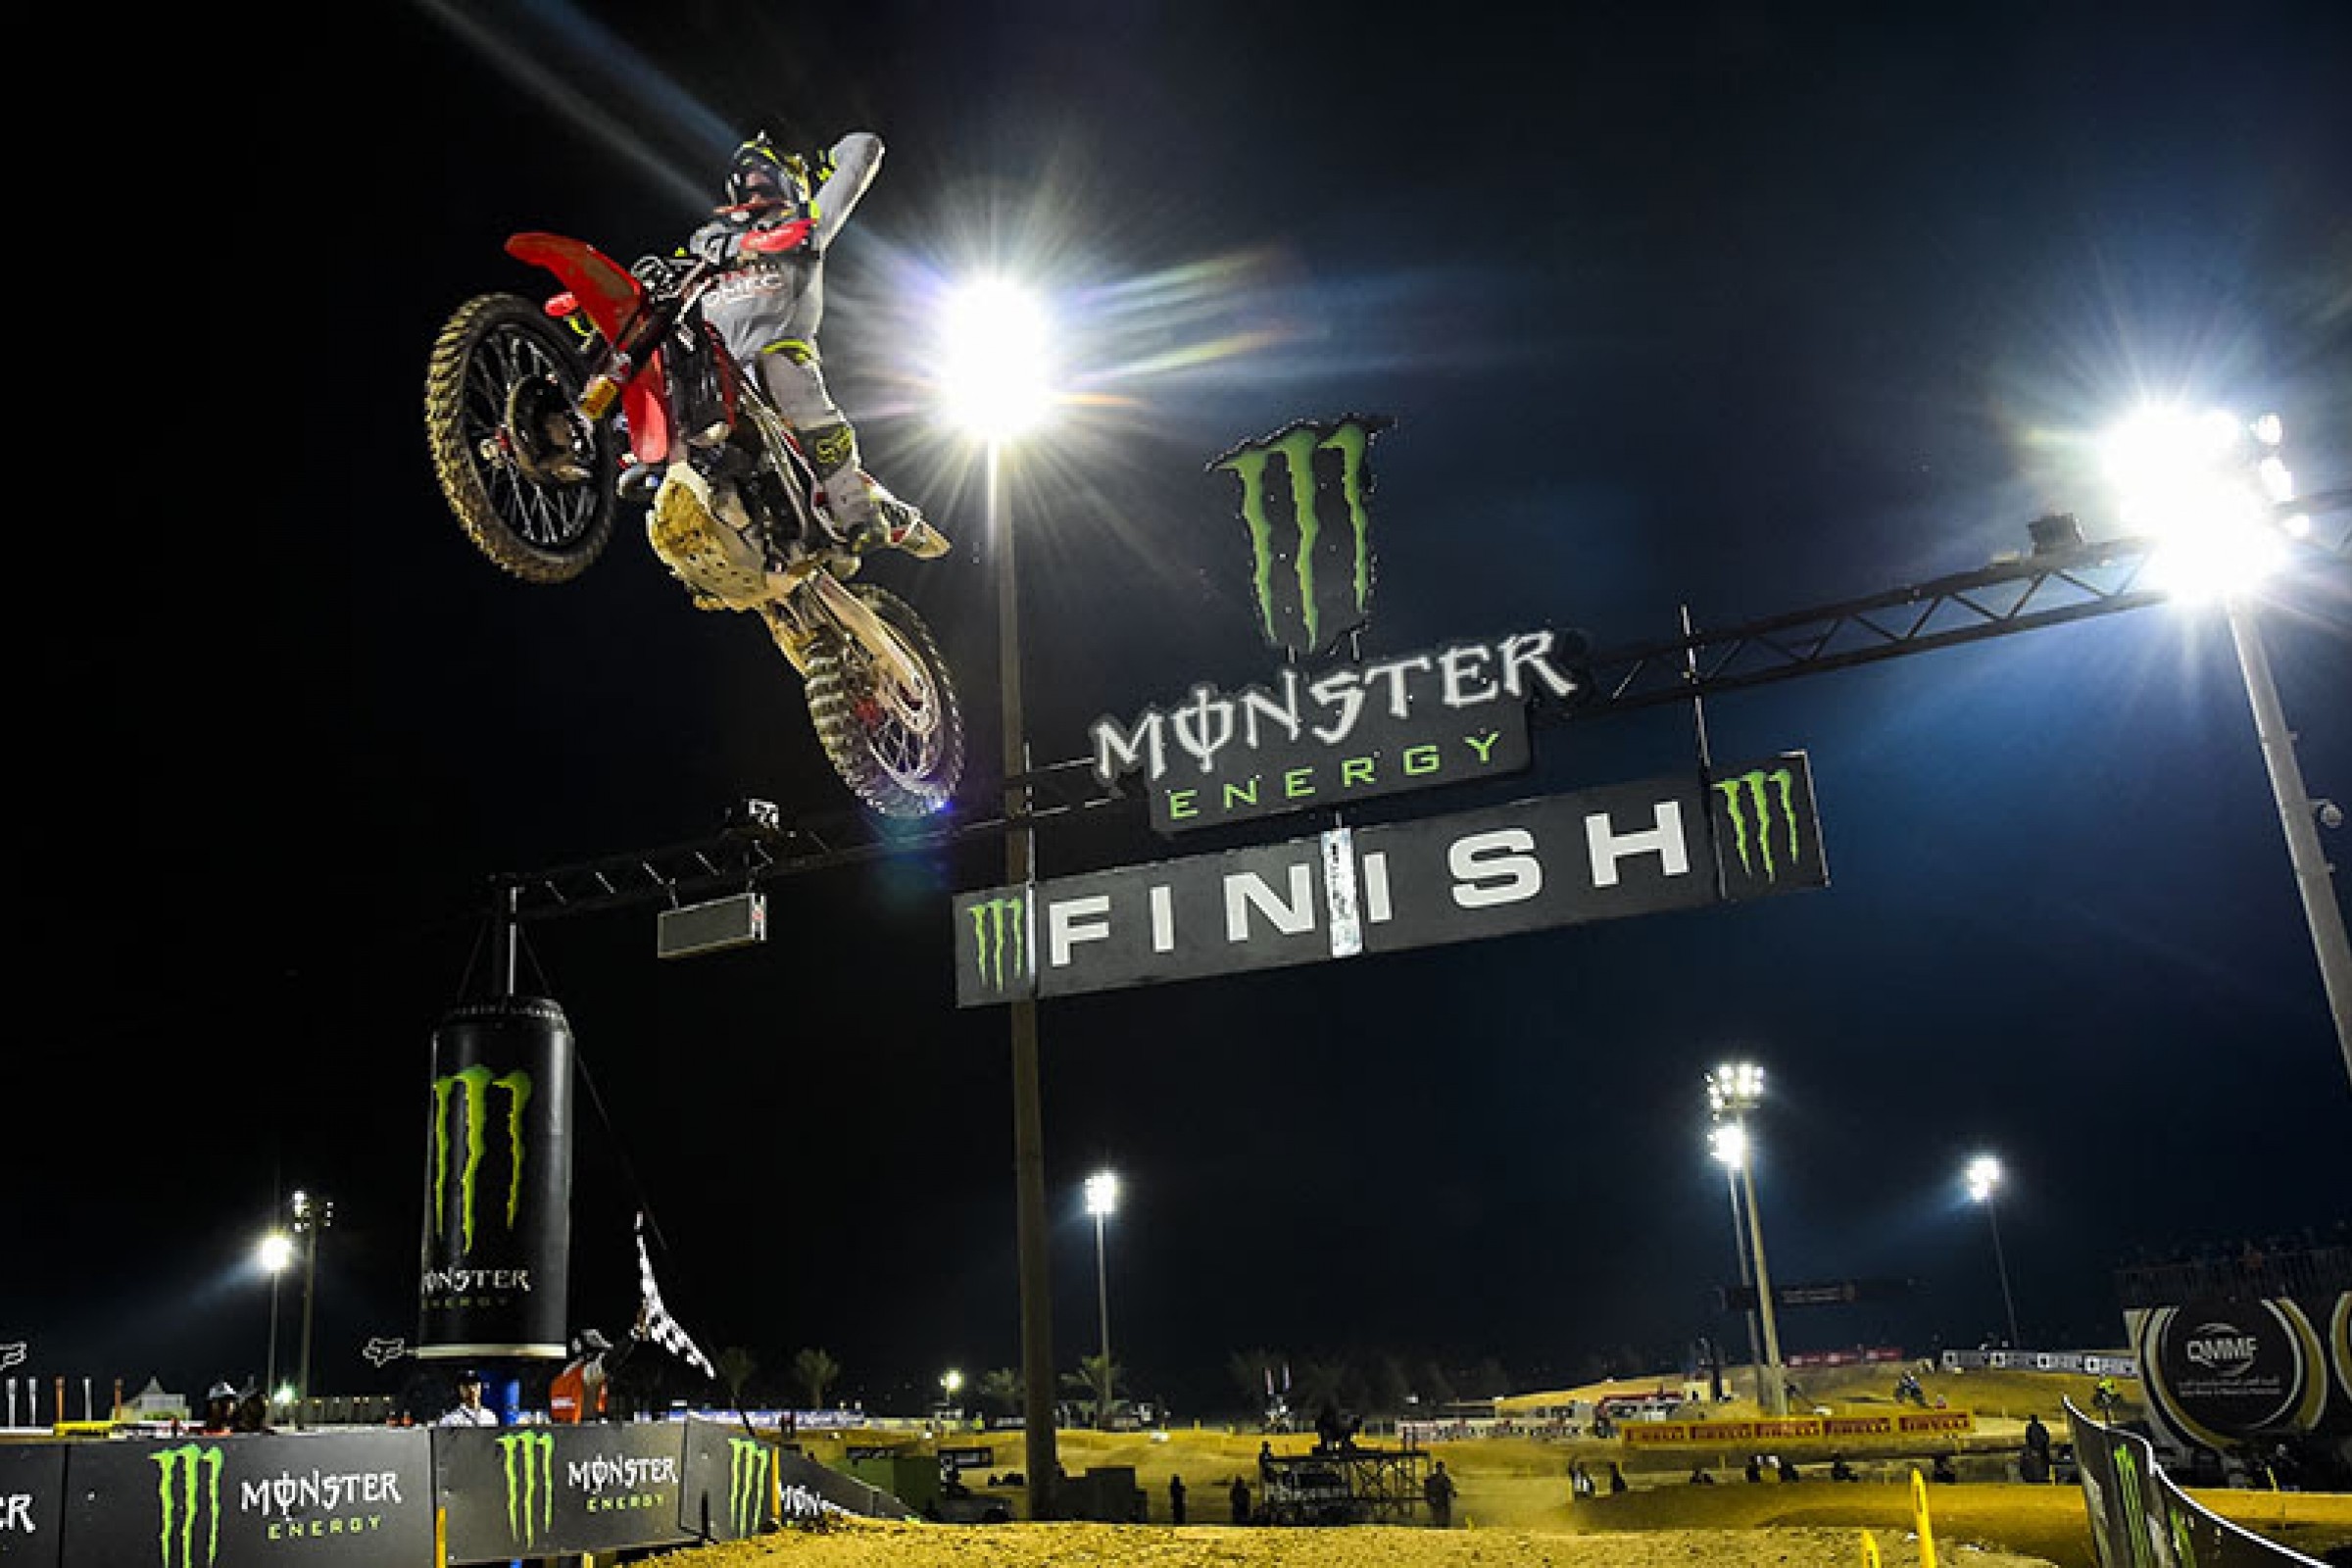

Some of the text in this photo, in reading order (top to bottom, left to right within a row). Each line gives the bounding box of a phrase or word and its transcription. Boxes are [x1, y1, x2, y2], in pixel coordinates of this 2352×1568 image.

[1169, 730, 1499, 820] ENERGY
[1049, 800, 1690, 967] FINISH
[420, 1266, 532, 1295] ONSTER
[587, 1494, 664, 1512] ENERGY
[268, 1515, 381, 1540] ENERGY
